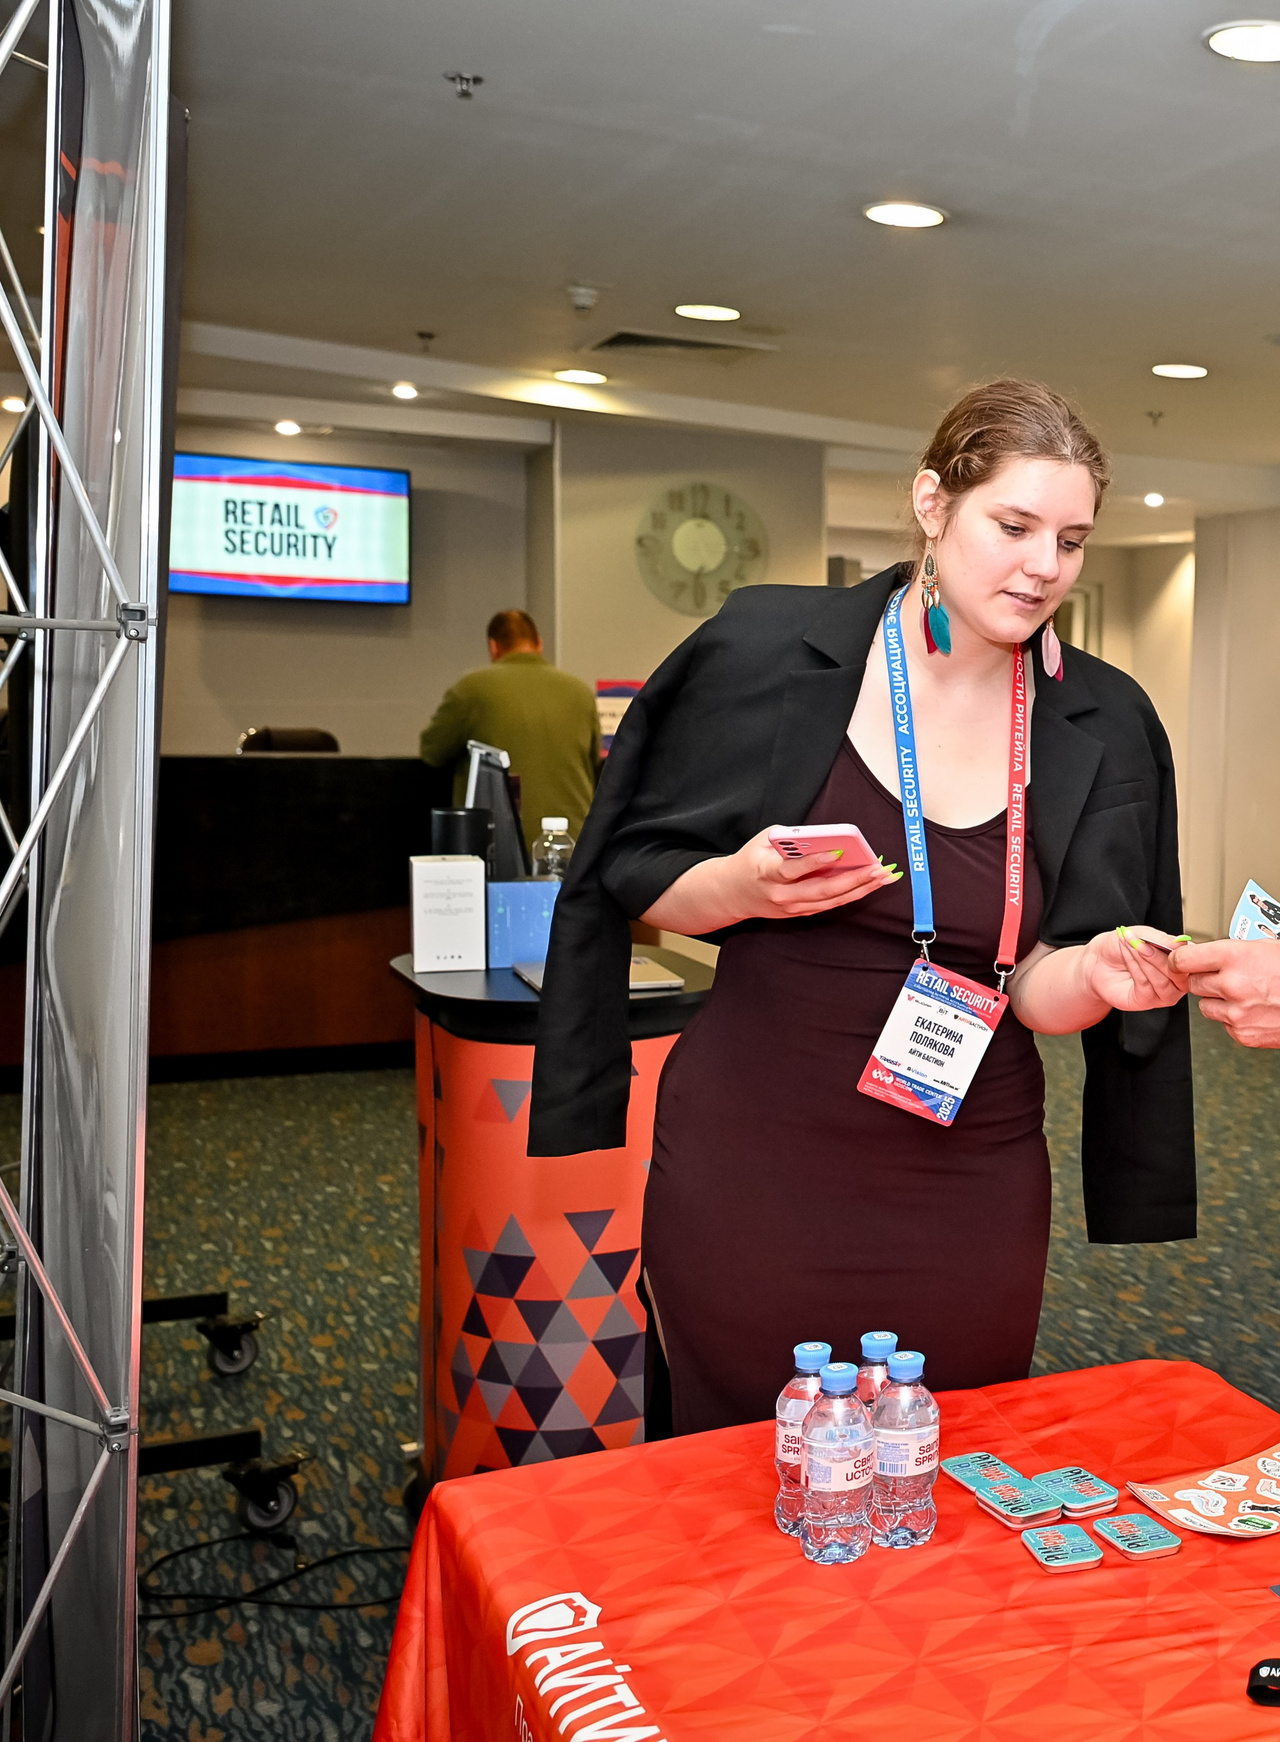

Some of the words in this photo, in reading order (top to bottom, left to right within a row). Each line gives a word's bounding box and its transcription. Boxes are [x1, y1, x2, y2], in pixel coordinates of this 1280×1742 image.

[224, 499, 305, 529] RETAIL
[224, 528, 337, 559] SECURITY
[886, 588, 904, 625] ЭКСП
[886, 628, 910, 735] АССОЦИАЦИЯ
[1013, 703, 1026, 772] РИТЕЙЛА
[901, 746, 919, 817] SECURITY
[1011, 783, 1023, 832] RETAIL
[908, 820, 925, 872] RETAIL
[1009, 836, 1021, 906] SECURITY
[915, 971, 950, 995] RETAIL
[951, 985, 998, 1014] SECURITY
[909, 1031, 956, 1058] ПОЛЯКОВА
[914, 1016, 964, 1044] ЕКАТЕРИНА
[908, 1047, 922, 1058] АЙТИ
[922, 1053, 945, 1067] БАСТИОН
[895, 1076, 911, 1087] WORLD
[911, 1083, 925, 1093] TRADE
[925, 1089, 942, 1100] CENTER
[936, 1095, 956, 1121] 2025
[525, 1641, 668, 1742] АЙТИ
